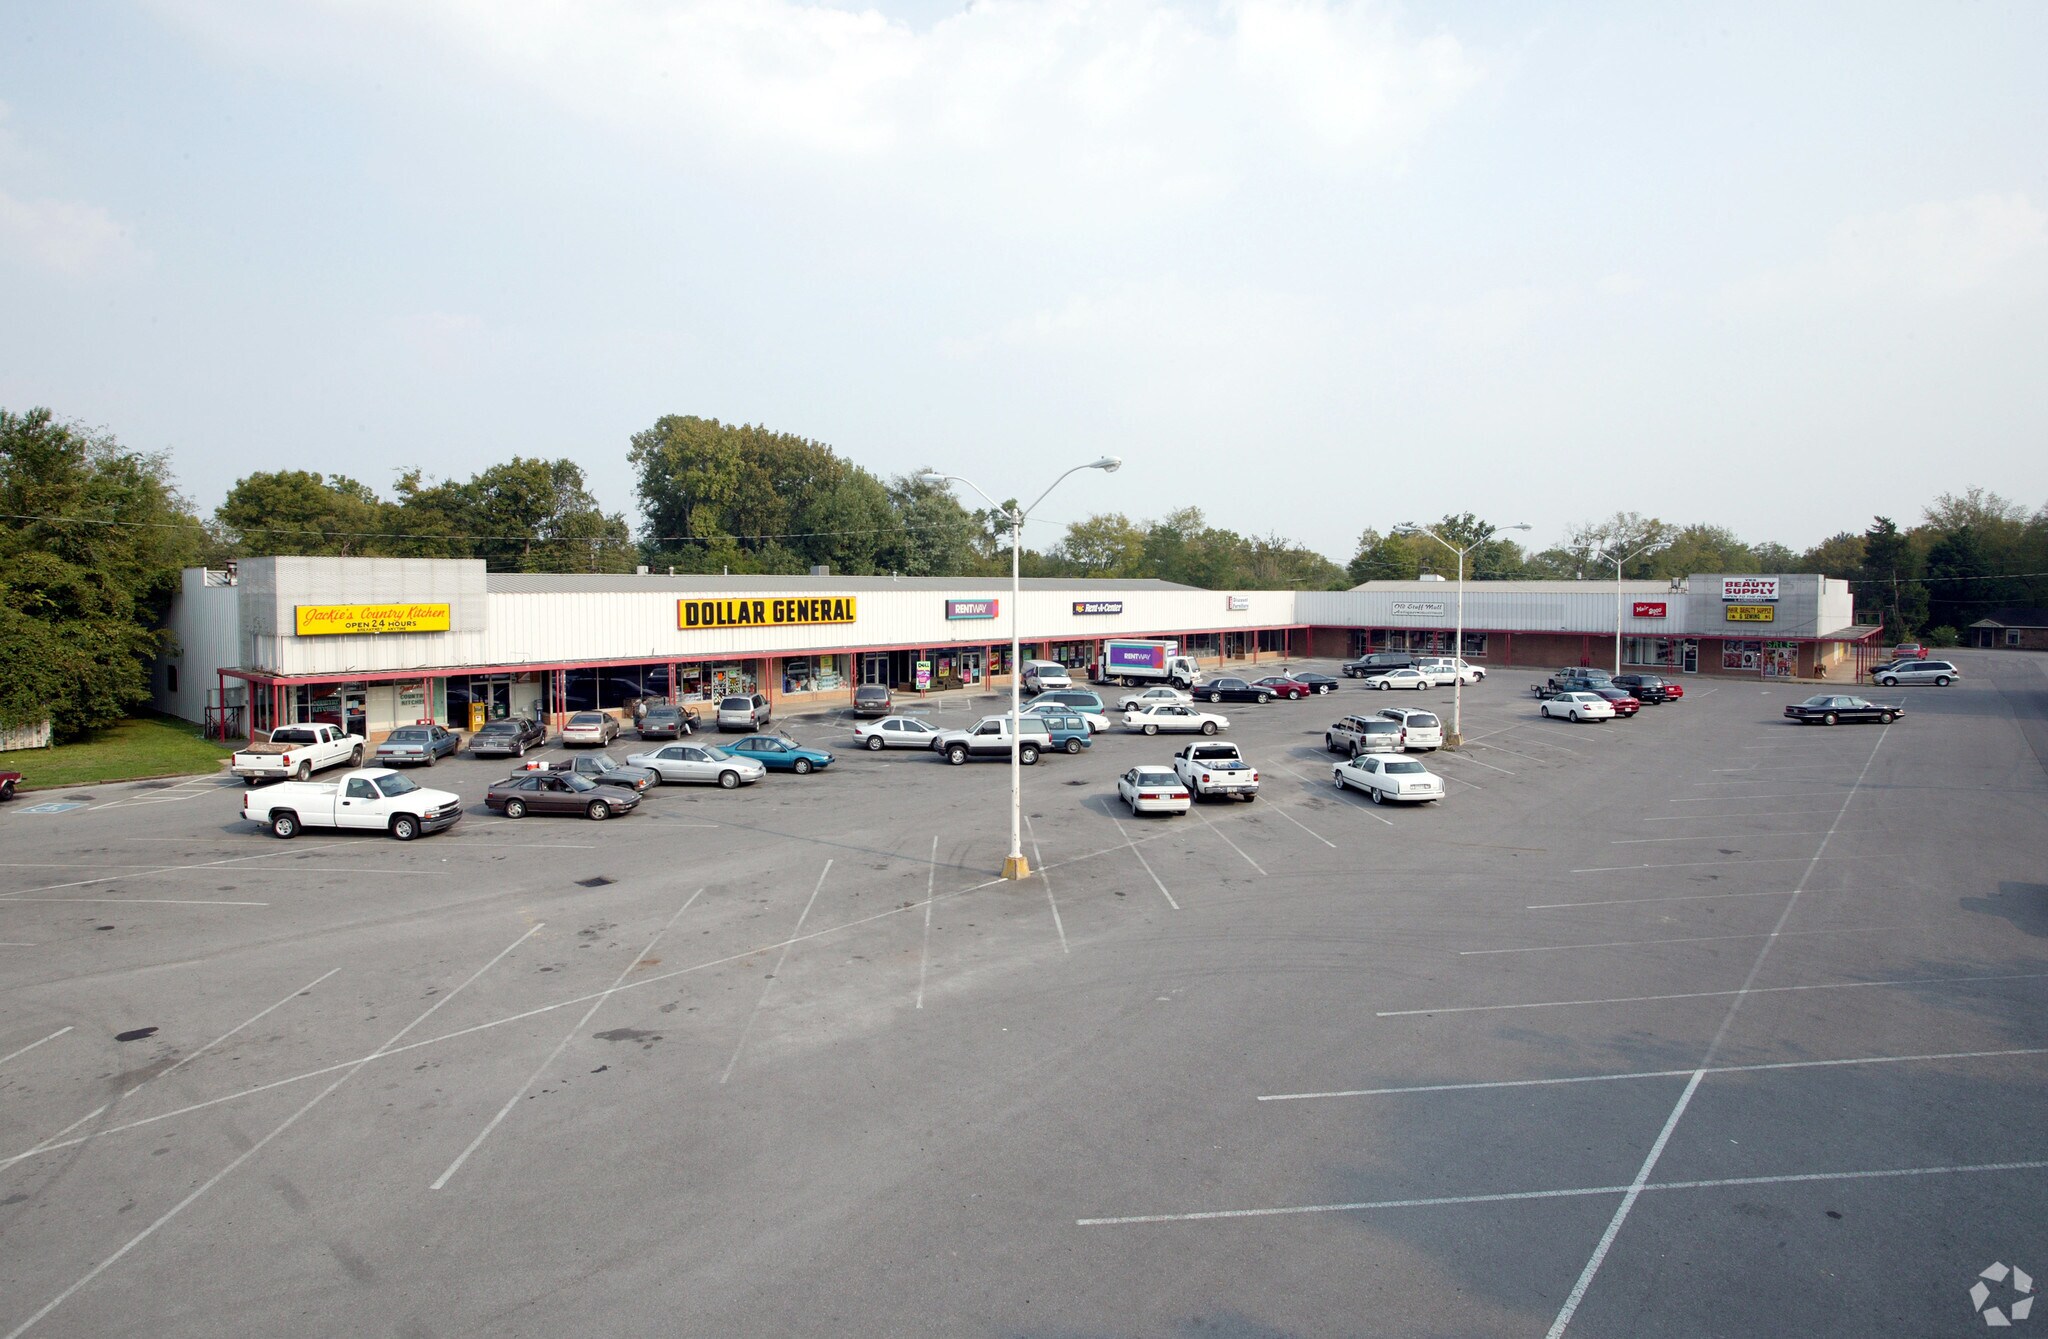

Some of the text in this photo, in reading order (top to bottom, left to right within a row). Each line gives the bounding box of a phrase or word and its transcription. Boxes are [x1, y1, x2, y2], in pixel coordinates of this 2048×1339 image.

[303, 606, 446, 626] Jackie's Country Kitchen
[685, 598, 854, 626] DOLLAR GENERAL
[1767, 640, 1793, 648] SALE
